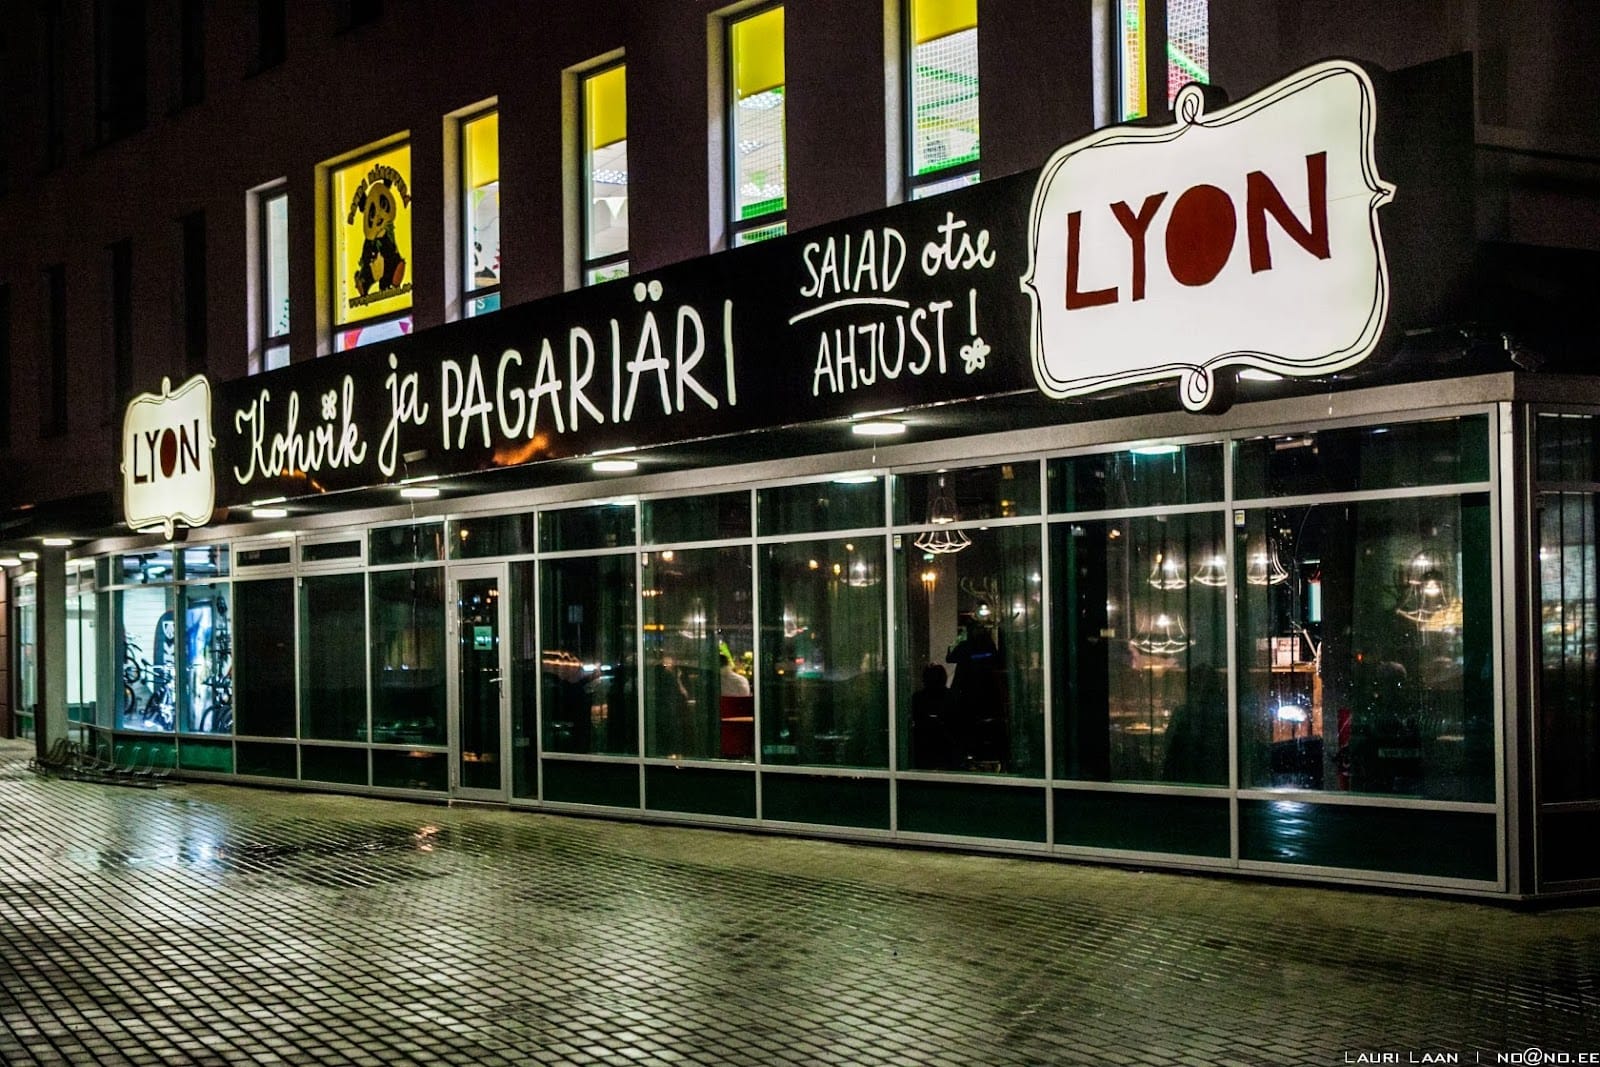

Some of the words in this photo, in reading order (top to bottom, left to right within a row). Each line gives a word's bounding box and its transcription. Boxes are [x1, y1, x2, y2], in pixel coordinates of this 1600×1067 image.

[921, 211, 996, 276] otse
[1066, 151, 1332, 311] LYON
[233, 374, 368, 485] Kohvik
[378, 353, 429, 477] ja
[441, 280, 737, 450] PAGARIÄRI
[133, 418, 201, 485] LYON
